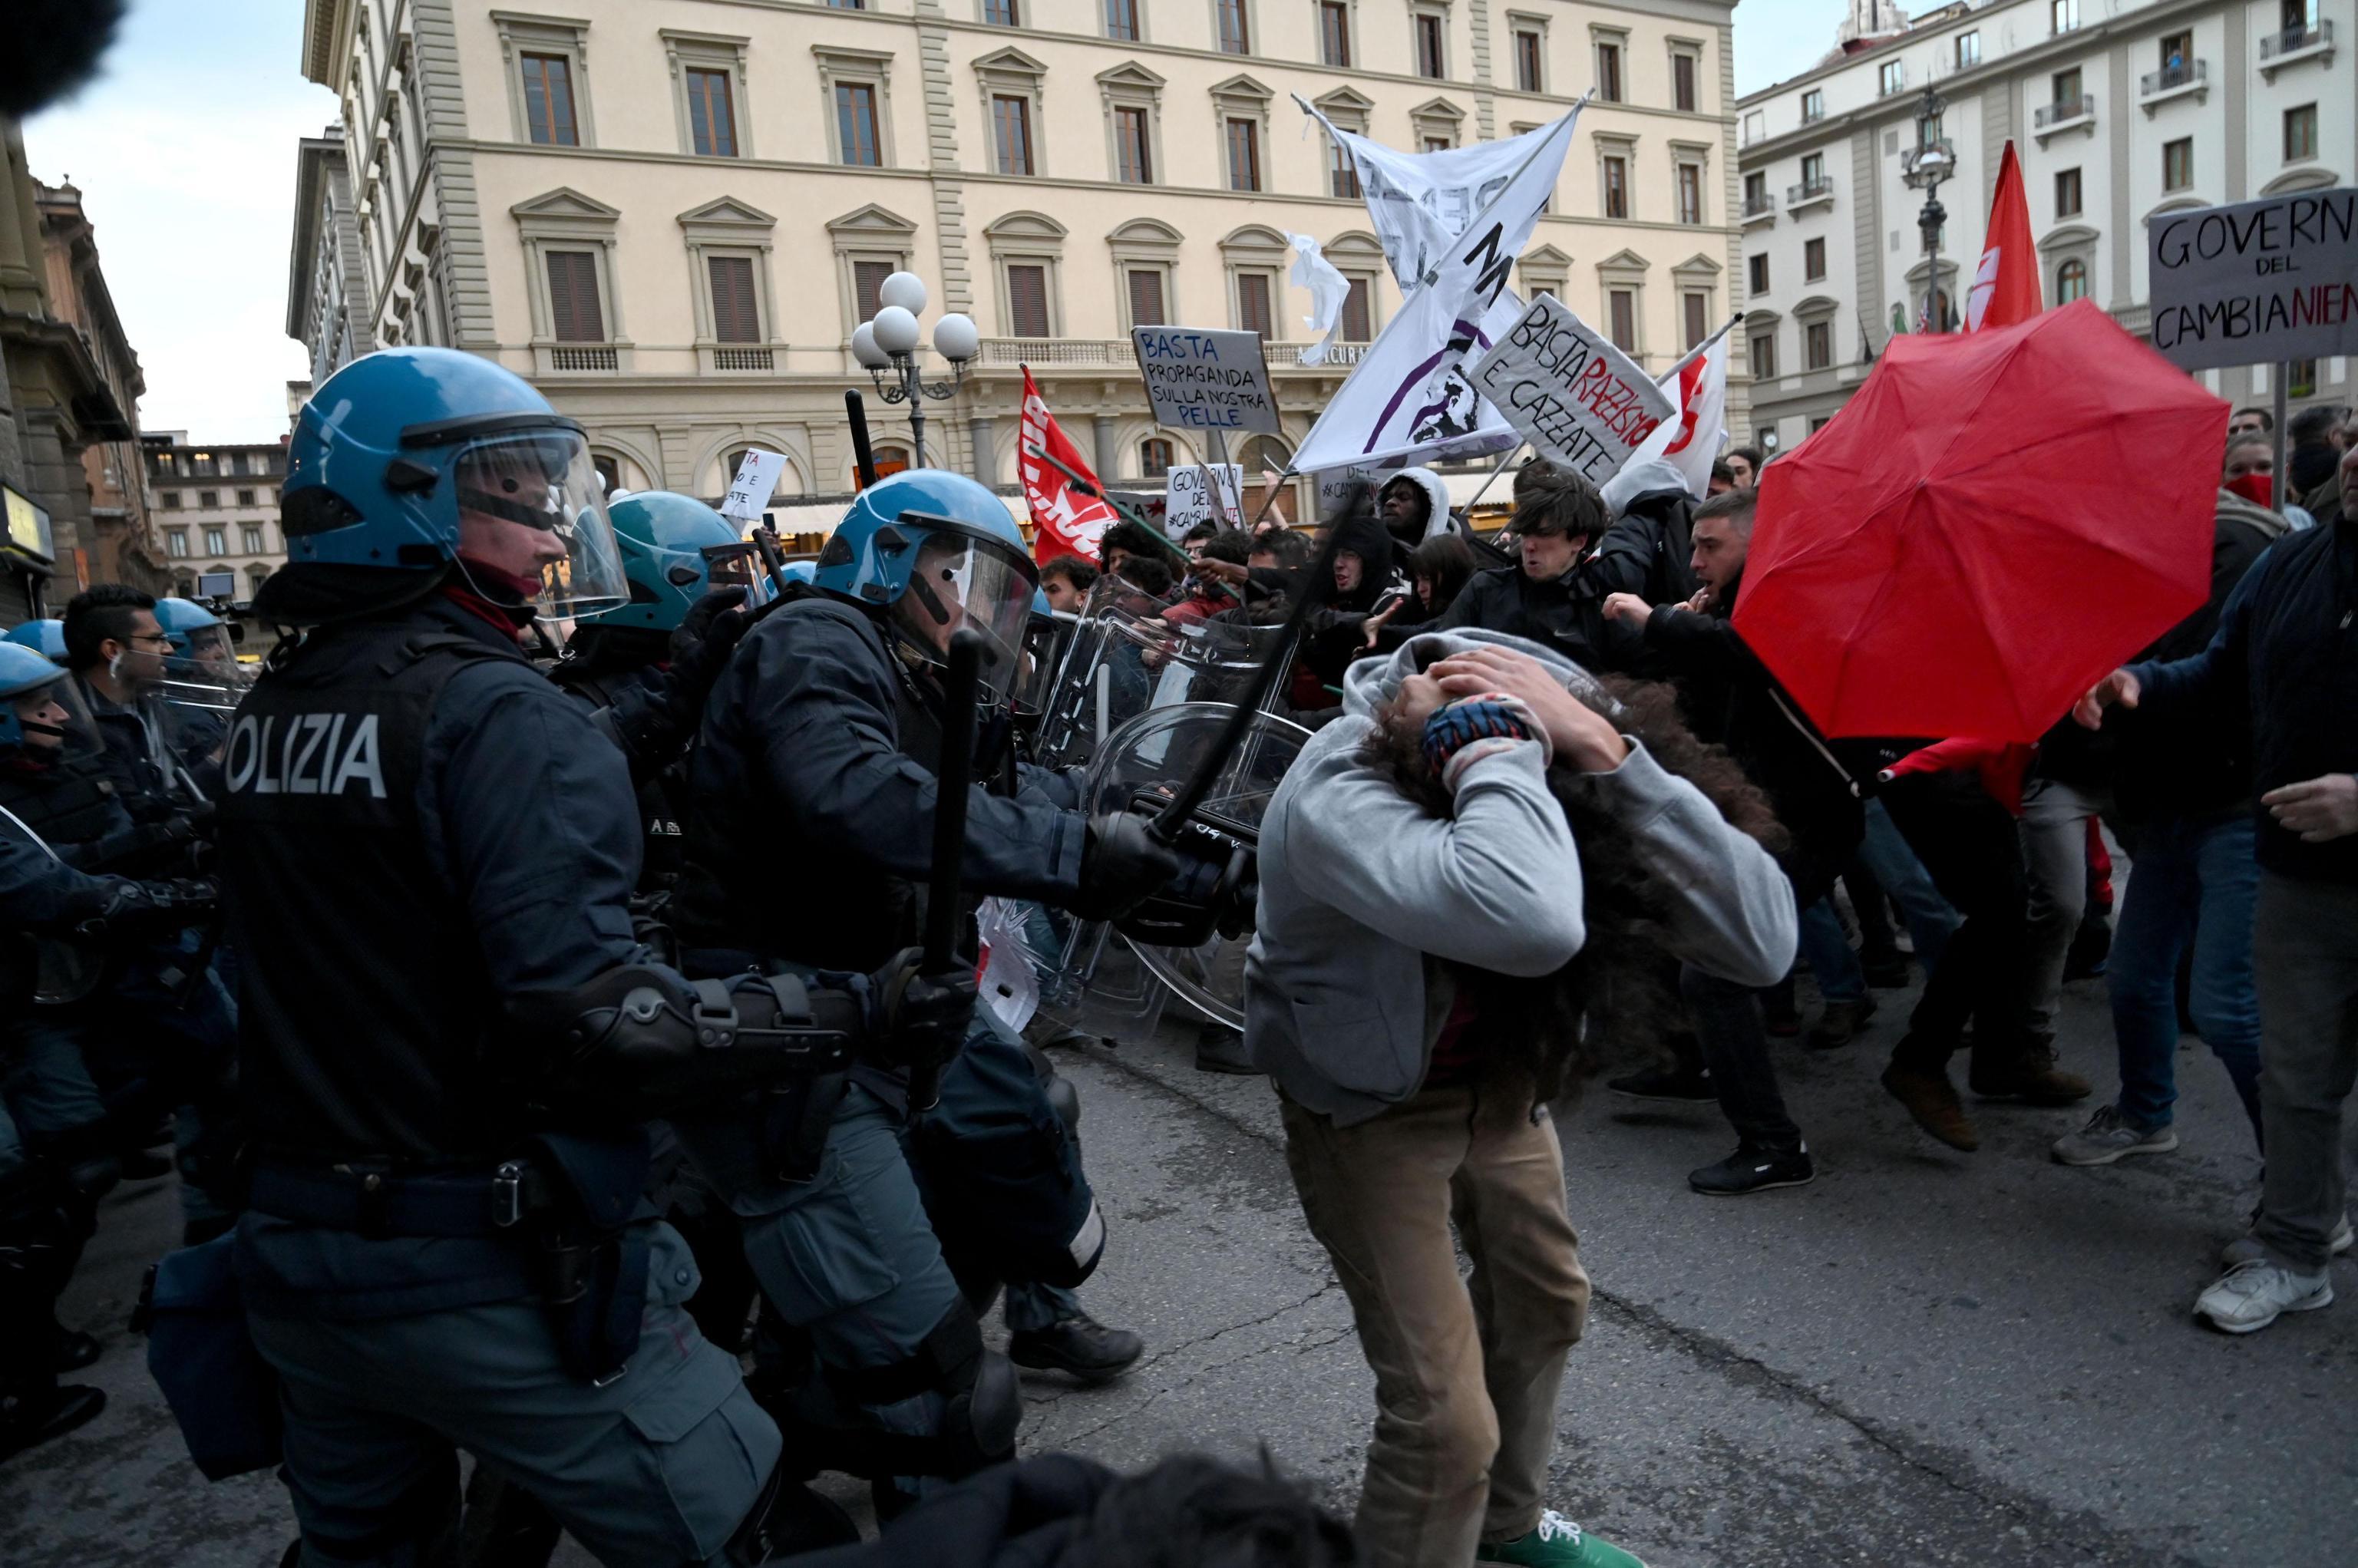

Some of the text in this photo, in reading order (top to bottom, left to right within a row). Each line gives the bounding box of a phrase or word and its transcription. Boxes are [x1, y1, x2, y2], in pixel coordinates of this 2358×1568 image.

[2158, 196, 2358, 269] GOVERN
[2255, 254, 2301, 276] DEL
[1141, 333, 1219, 361] BASTA
[1147, 363, 1257, 388] PROPAGANDA
[1510, 304, 1590, 388] BASTA
[1569, 357, 1660, 447] RAZZISMO
[1152, 385, 1268, 411] SULLA NOSTRA
[1178, 405, 1243, 427] PELLE
[1484, 358, 1509, 388] E
[1510, 380, 1614, 482] CAZZATE
[749, 475, 758, 486] E
[725, 491, 749, 503] ATE
[222, 713, 387, 798] OLIZIA
